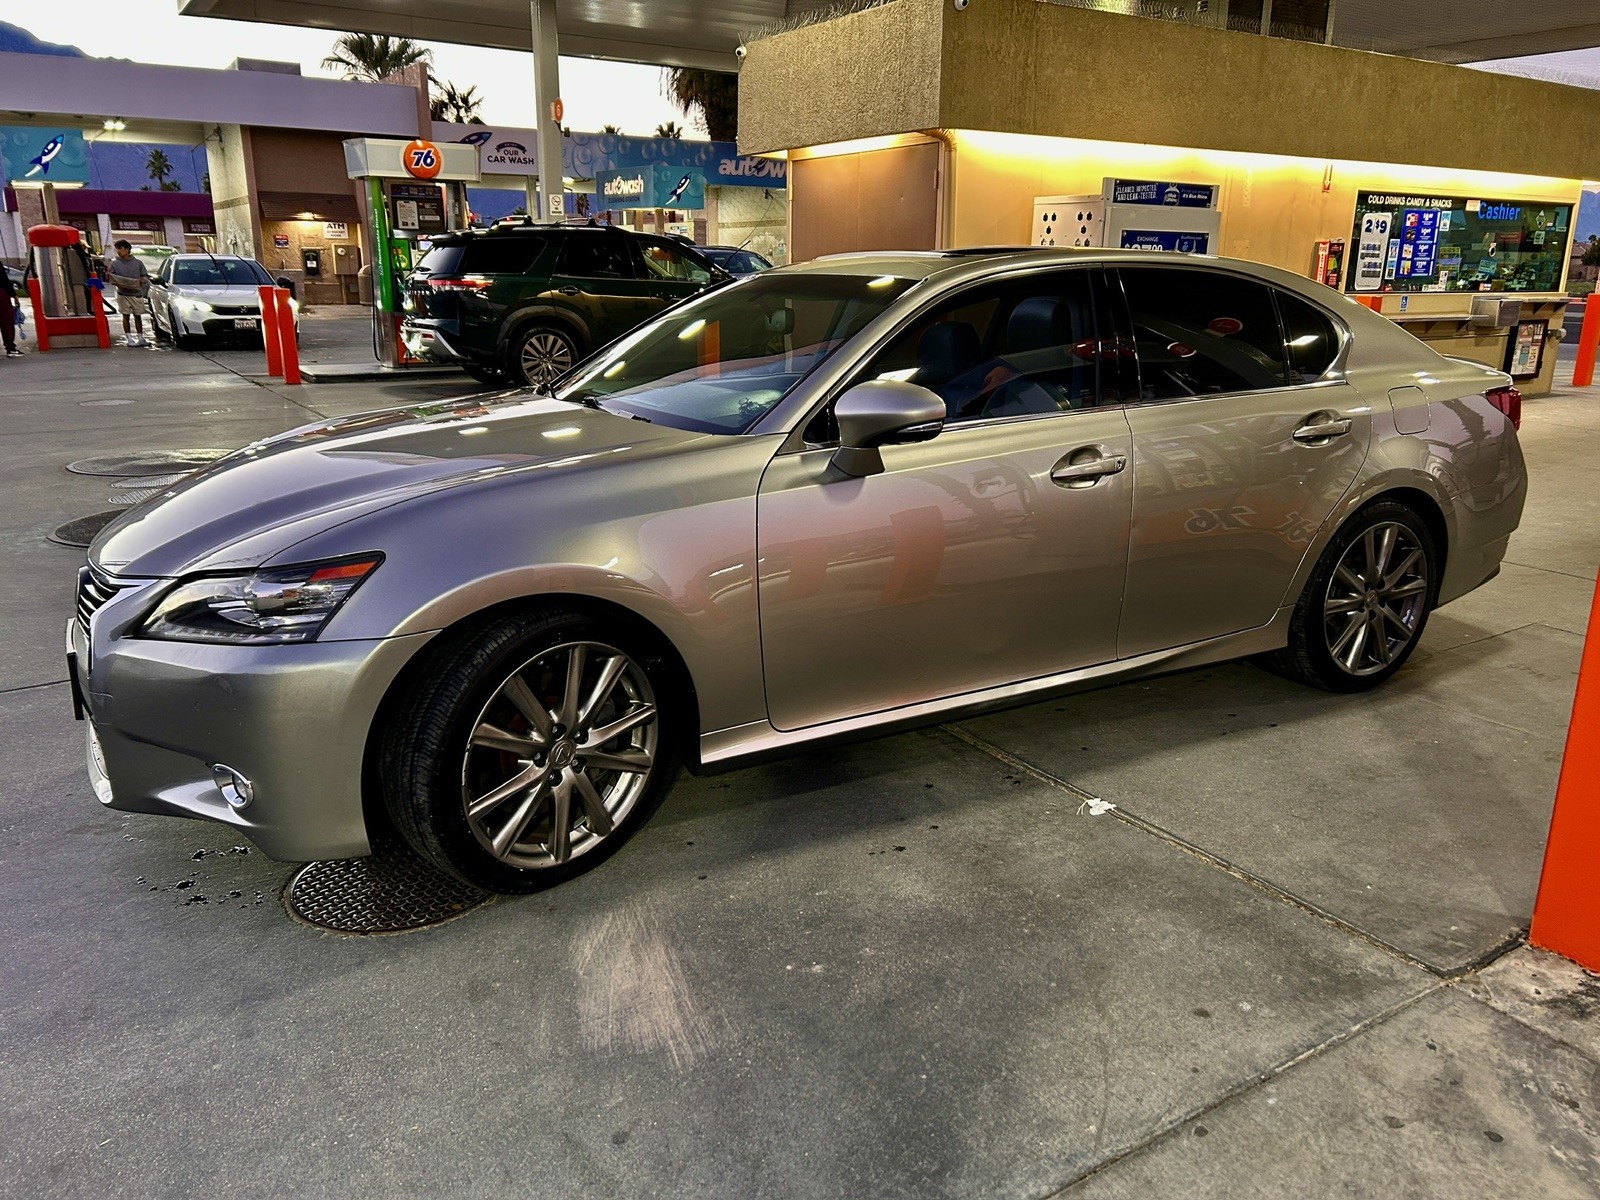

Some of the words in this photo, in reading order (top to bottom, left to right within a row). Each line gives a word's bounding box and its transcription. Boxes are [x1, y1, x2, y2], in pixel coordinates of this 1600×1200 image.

[410, 148, 436, 169] 76
[487, 155, 506, 164] CAR
[508, 156, 534, 165] WASH
[719, 156, 787, 178] autow
[603, 174, 644, 195] autowash
[1368, 194, 1384, 204] COLD
[1384, 195, 1406, 206] DRINKS
[1406, 196, 1425, 207] CANDY
[1425, 198, 1430, 207] &
[1431, 198, 1453, 208] SNACKS
[1478, 201, 1521, 220] Cashier
[326, 222, 345, 230] ATM
